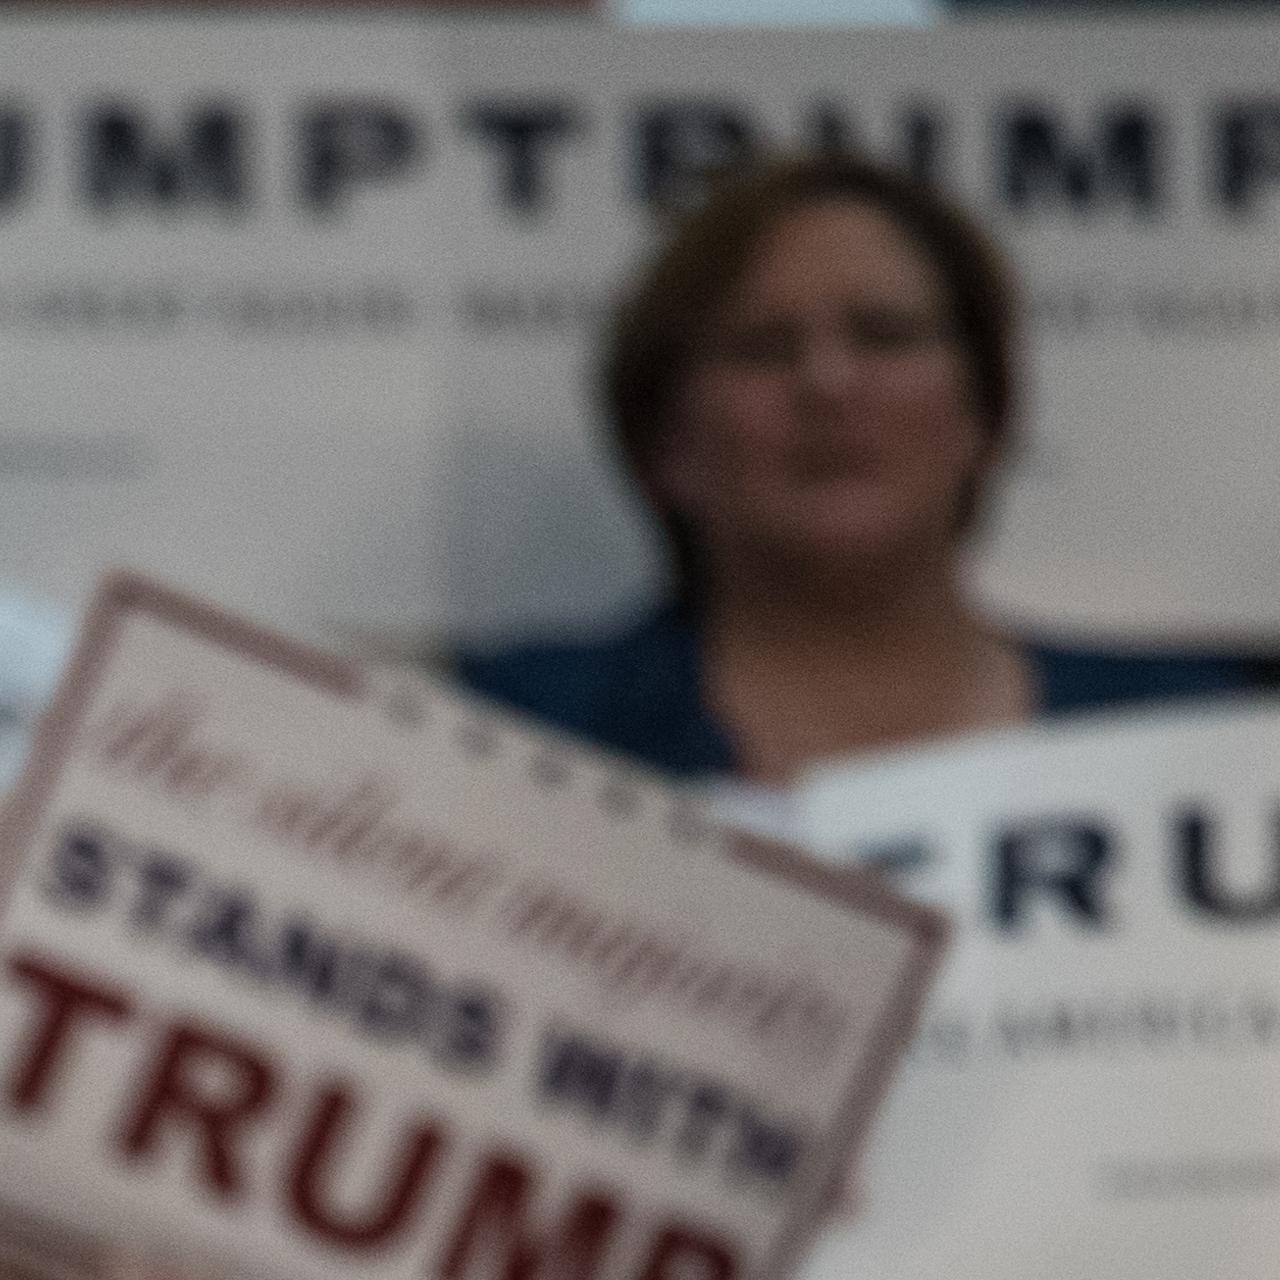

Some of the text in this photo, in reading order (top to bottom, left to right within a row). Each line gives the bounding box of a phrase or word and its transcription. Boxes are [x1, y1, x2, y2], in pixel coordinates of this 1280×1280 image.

[848, 798, 1280, 940] RU
[48, 822, 808, 1190] STANDS WITH
